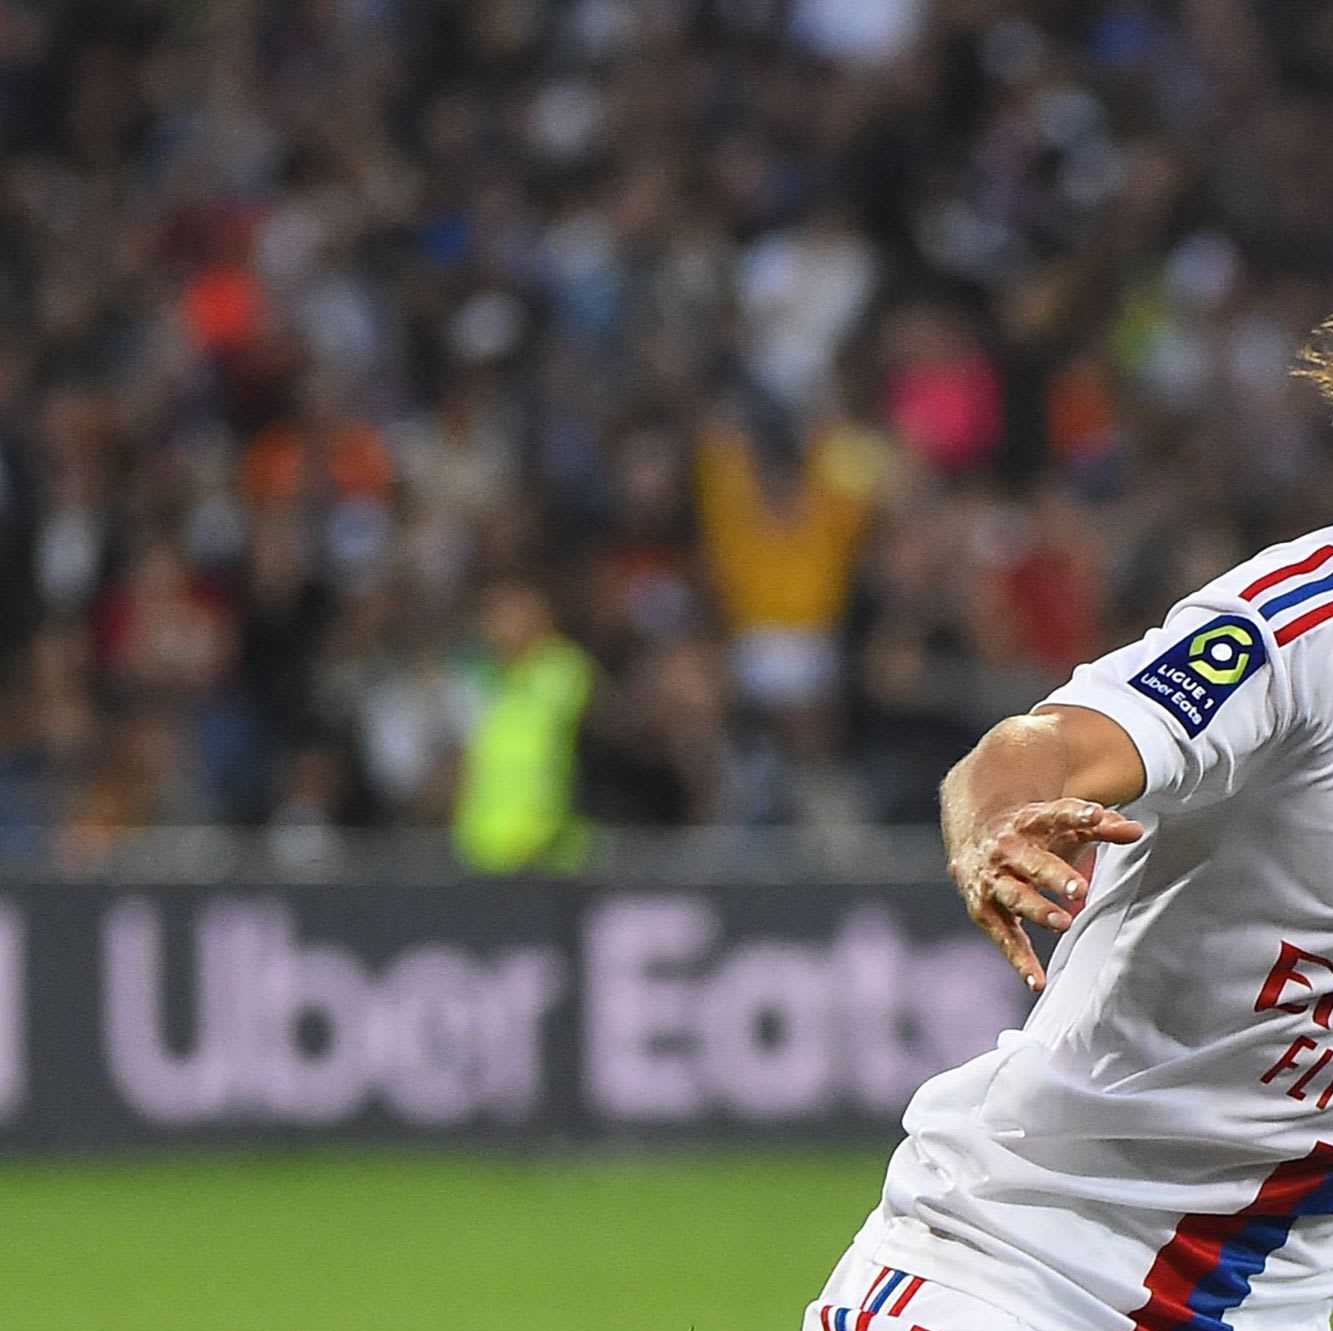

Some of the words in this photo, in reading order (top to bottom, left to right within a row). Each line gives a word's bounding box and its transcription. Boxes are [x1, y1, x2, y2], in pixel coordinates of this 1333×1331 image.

[1140, 673, 1174, 696] Uber
[1171, 691, 1203, 725] Eats
[1157, 664, 1206, 700] LIGUE
[1203, 698, 1215, 710] 1
[102, 893, 562, 1124] Uber
